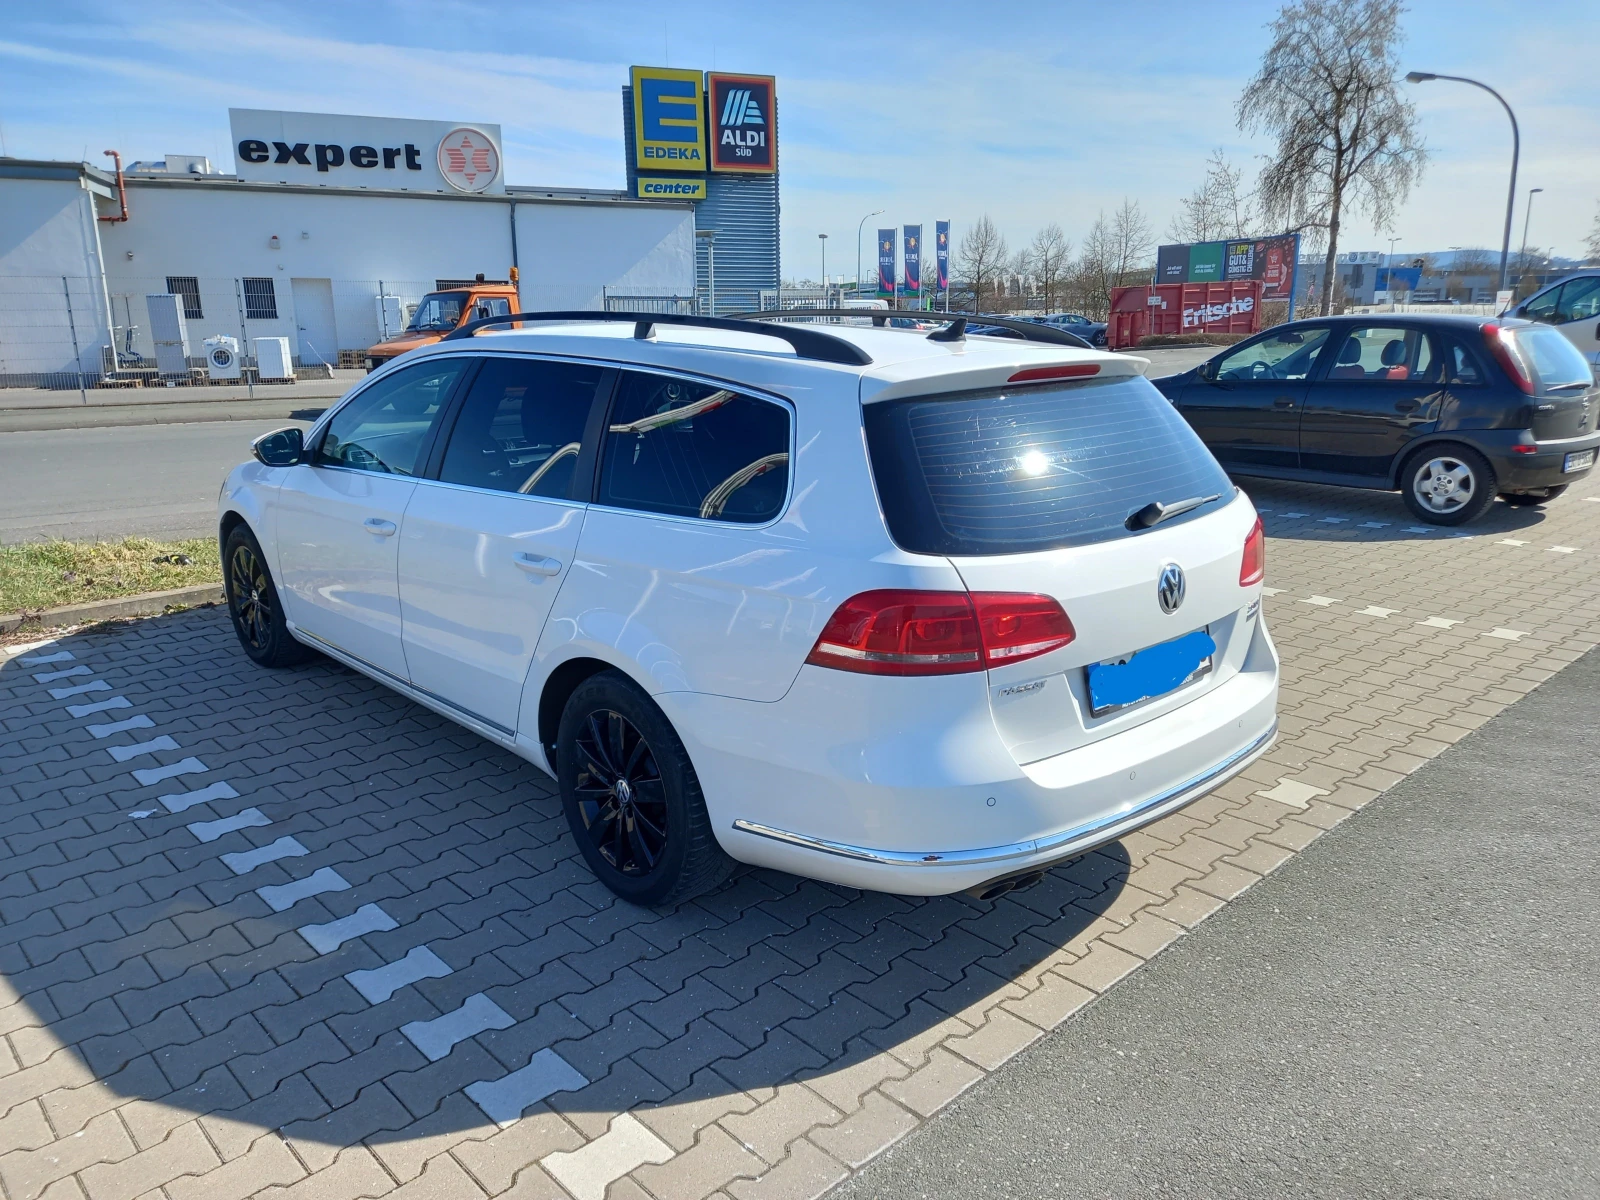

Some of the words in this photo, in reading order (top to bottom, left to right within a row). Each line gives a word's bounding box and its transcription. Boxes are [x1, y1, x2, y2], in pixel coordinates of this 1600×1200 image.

[721, 129, 765, 147] ALDI
[238, 139, 422, 172] expert
[643, 146, 701, 160] EDEKA
[735, 146, 752, 157] SÜD
[644, 183, 700, 195] center
[1183, 296, 1254, 328] Fritsche
